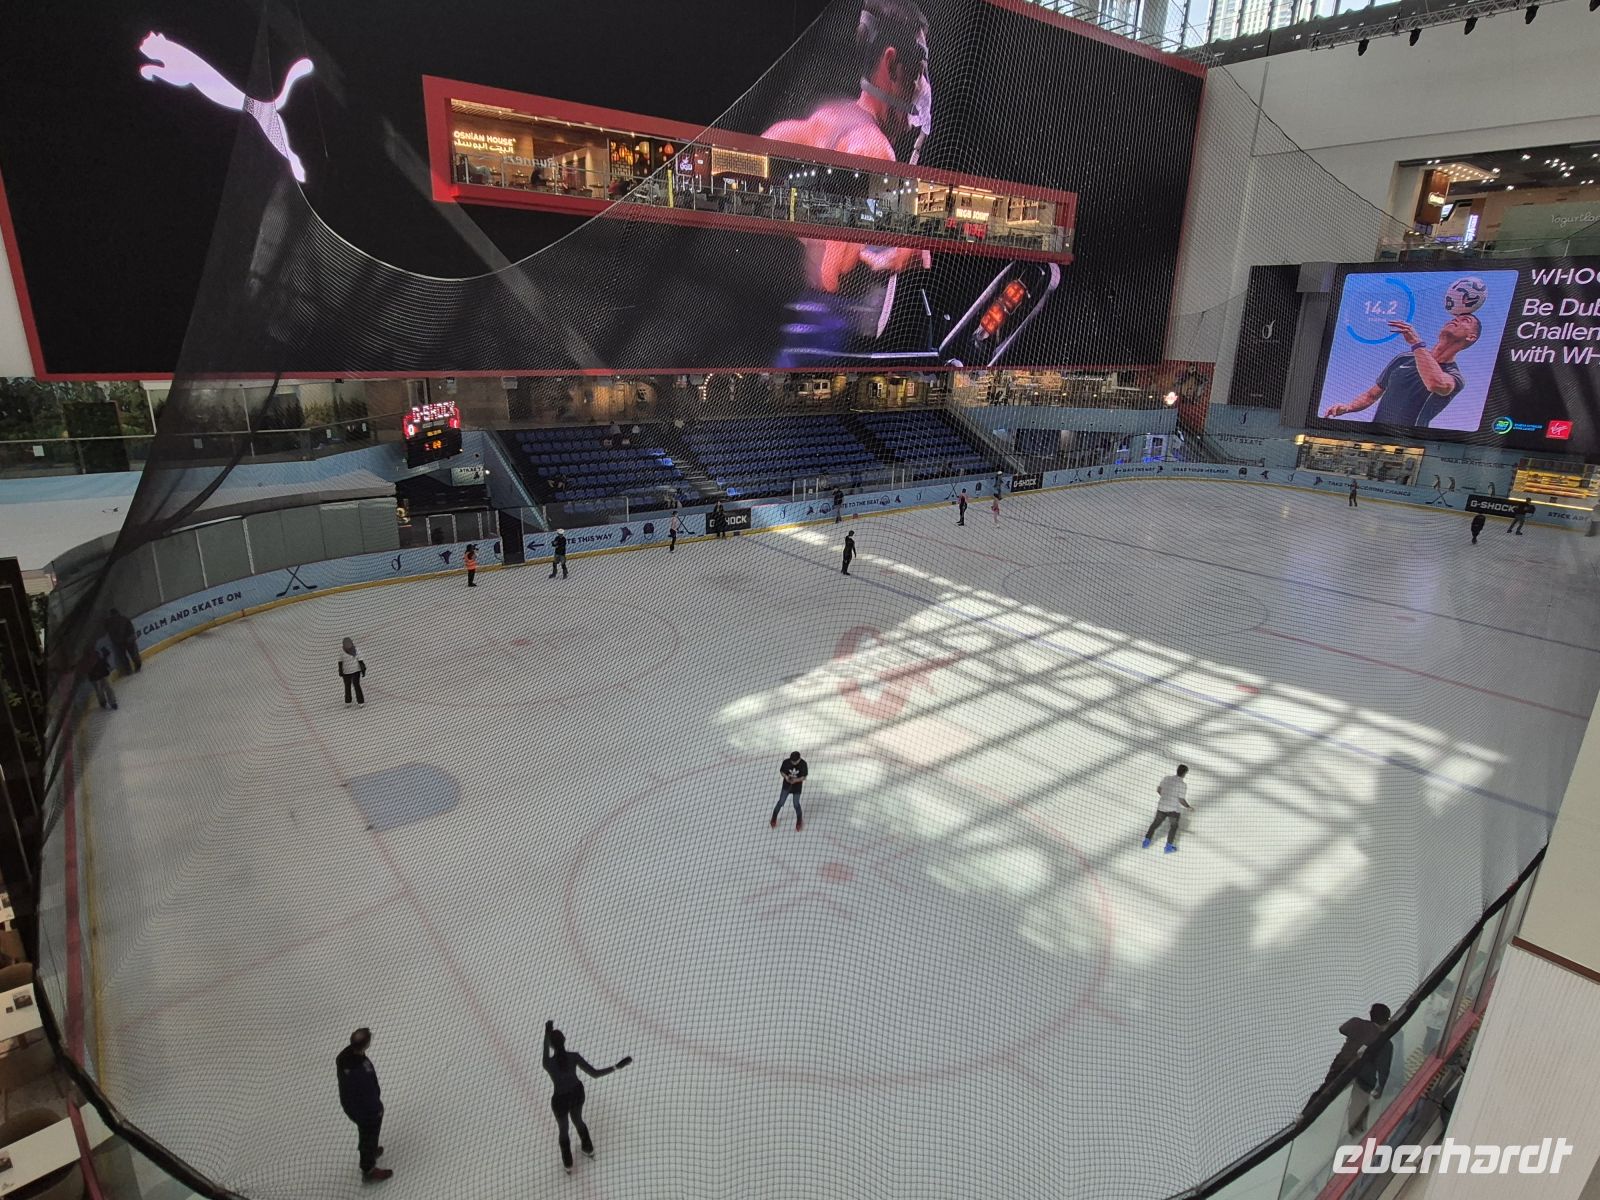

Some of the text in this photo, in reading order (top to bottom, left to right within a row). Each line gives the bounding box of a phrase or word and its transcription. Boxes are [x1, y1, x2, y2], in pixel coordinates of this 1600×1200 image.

[1531, 267, 1600, 285] WHO
[1364, 300, 1398, 315] 14.2
[1522, 298, 1554, 316] Be
[1510, 345, 1556, 363] with
[1013, 477, 1037, 489] G-SHOCK
[1470, 499, 1517, 514] G-SHOCK
[1547, 511, 1571, 520] STICK
[578, 535, 595, 543] THIS
[595, 533, 613, 541] WAY
[143, 617, 168, 636] CALM
[170, 608, 191, 623] AND
[192, 596, 225, 615] SKATE
[226, 591, 243, 602] ON
